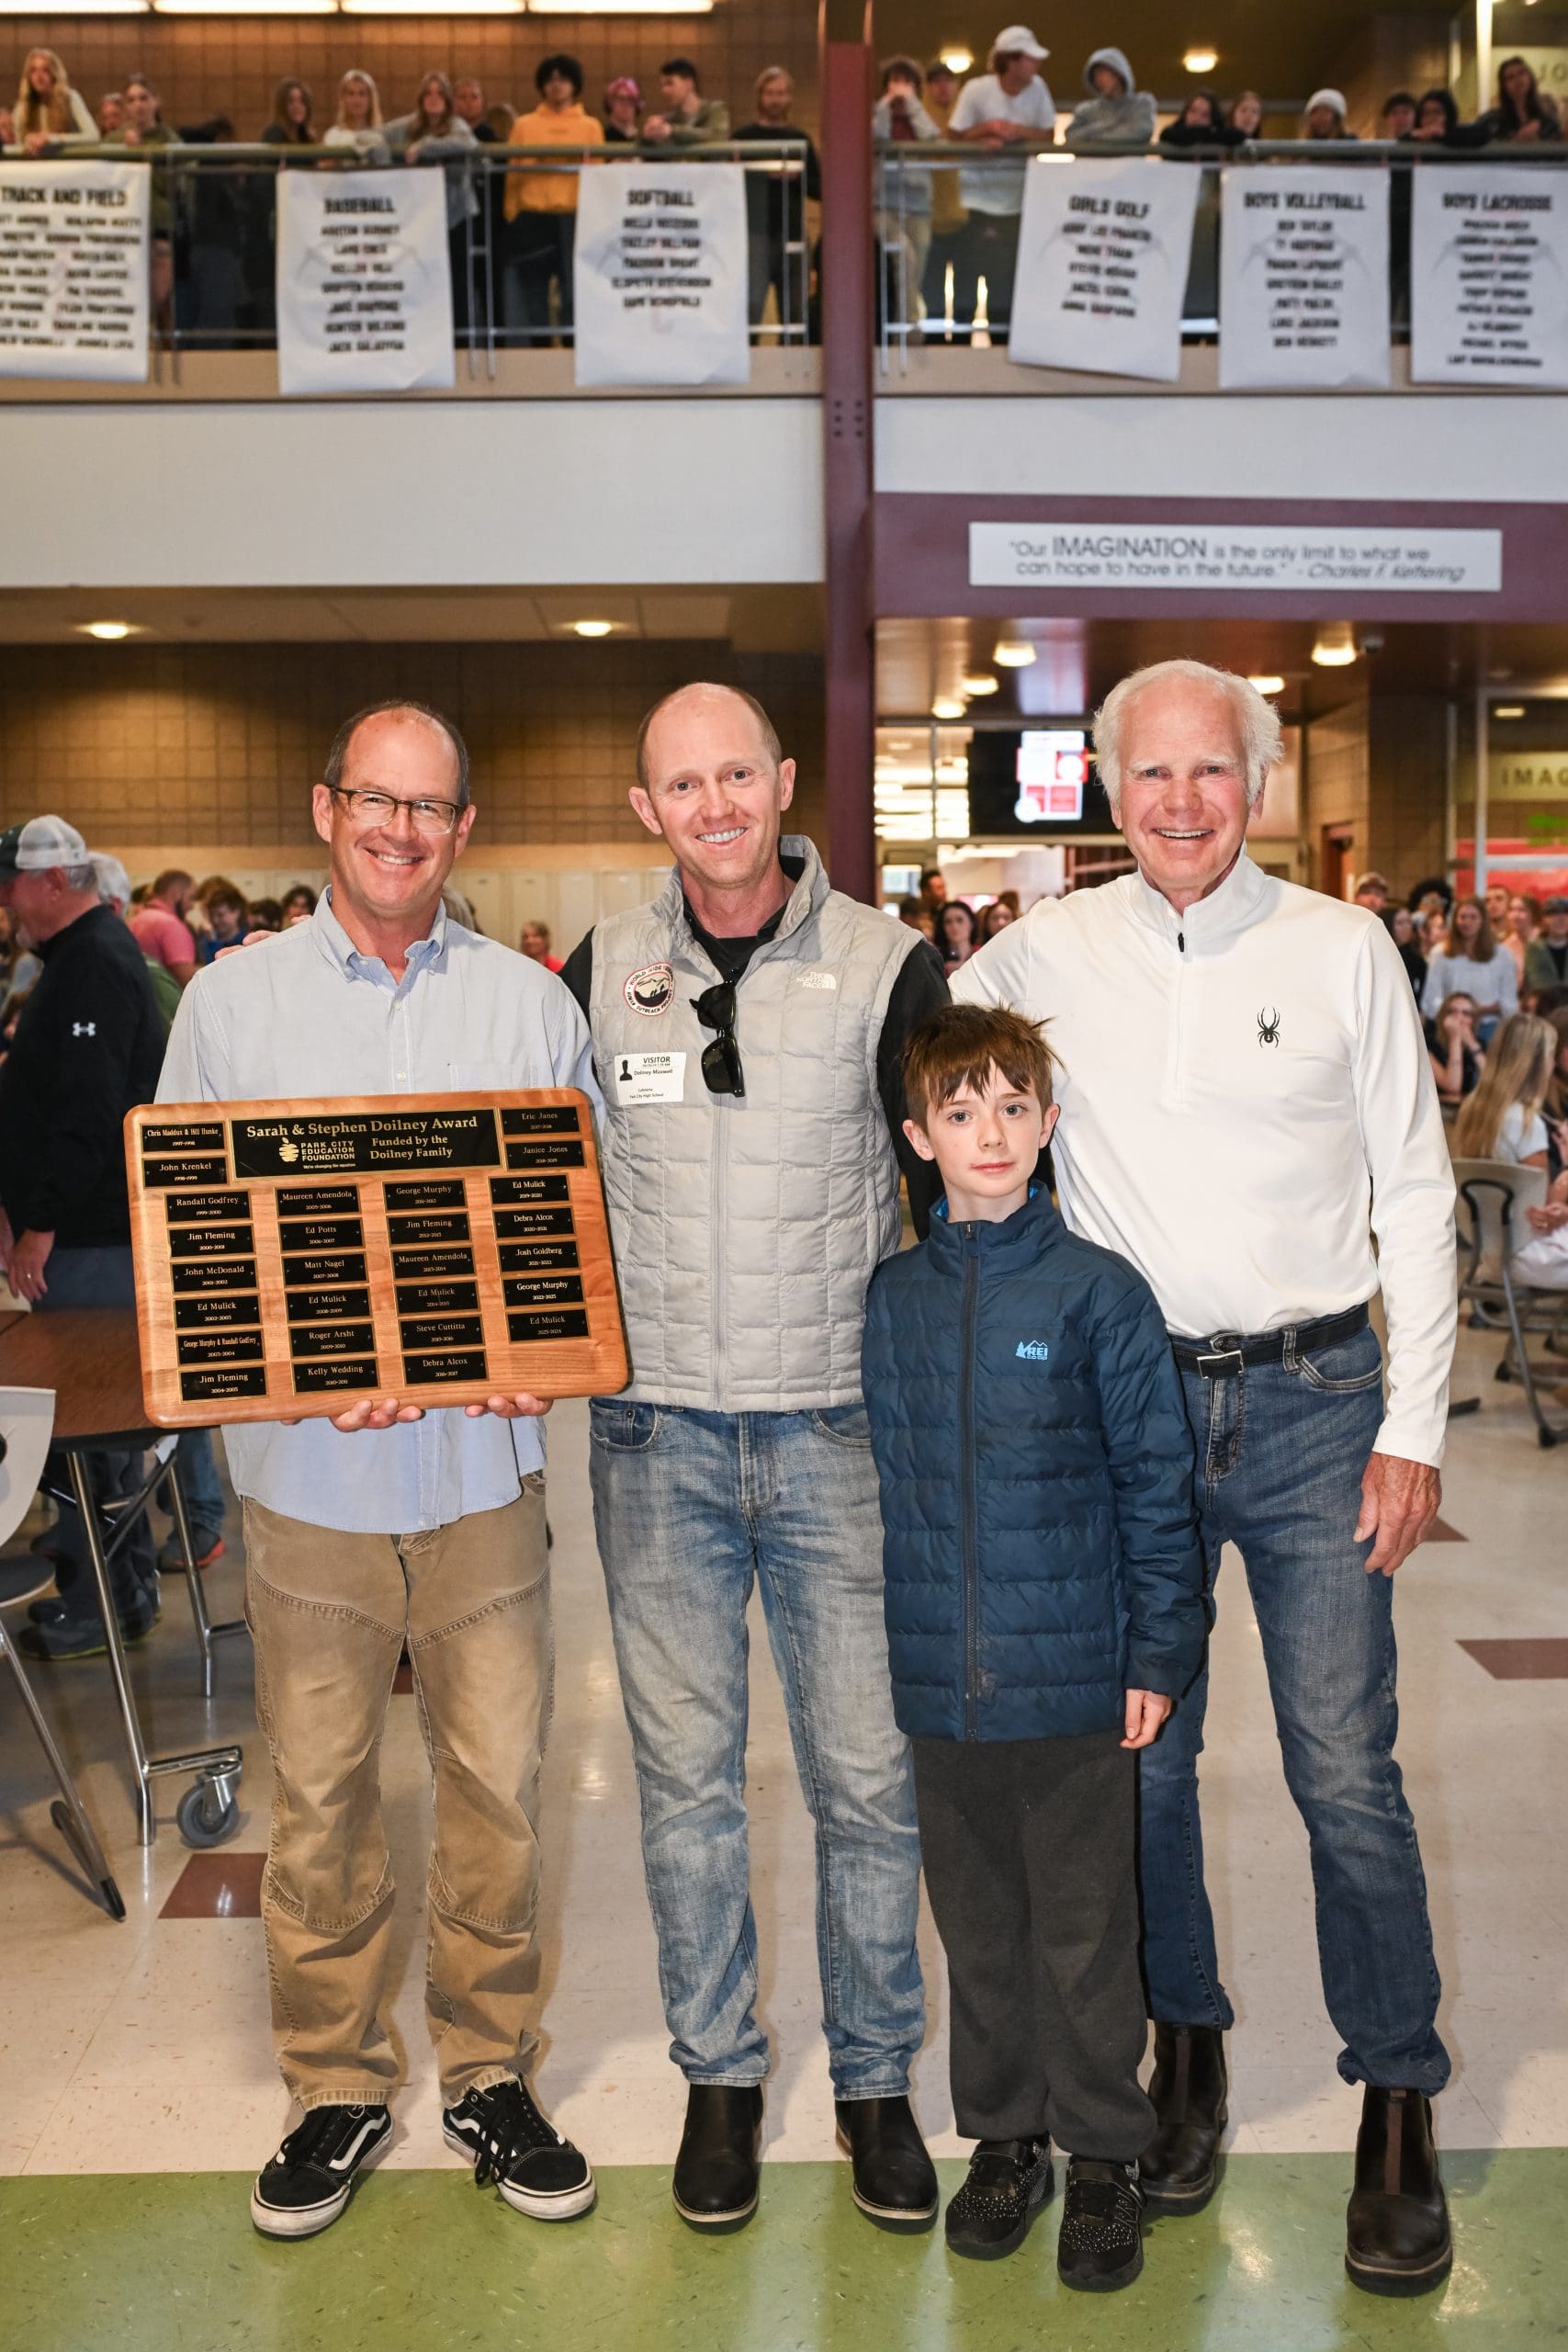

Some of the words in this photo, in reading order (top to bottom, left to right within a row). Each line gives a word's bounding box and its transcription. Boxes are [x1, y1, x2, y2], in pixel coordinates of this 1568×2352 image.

[1, 187, 46, 203] TRACK
[52, 189, 81, 205] AND
[86, 189, 127, 208] FIELD
[627, 190, 694, 207] SOFTBALL
[1244, 193, 1279, 209] BOYS
[1285, 193, 1365, 210] VOLLEYBALL
[1443, 194, 1477, 209] BOYS
[1483, 195, 1551, 210] LACROSSE
[324, 197, 396, 214] BASEBALL
[1068, 196, 1111, 214] GIRLS
[1115, 200, 1150, 219] GOLF
[1052, 537, 1207, 558] IMAGINATION
[1214, 544, 1226, 559] is
[1231, 544, 1258, 559] the
[1262, 545, 1295, 561] only
[1301, 545, 1336, 560] limit
[1340, 546, 1357, 560] to
[1359, 546, 1401, 560] what
[1406, 548, 1431, 561] we
[1016, 562, 1049, 576] can
[1055, 560, 1101, 578] hope
[1106, 561, 1122, 575] to
[1126, 561, 1170, 576] have
[1176, 561, 1190, 576] in
[1195, 561, 1221, 576] the
[1306, 562, 1371, 579] Charles
[1391, 564, 1466, 582] Kettering
[630, 969, 647, 986] WORLD
[636, 1005, 660, 1014] OUTREACH
[522, 1113, 536, 1121] Eric
[246, 1124, 288, 1137] Sarah
[292, 1124, 305, 1136] &
[308, 1122, 367, 1137] Stephen
[370, 1119, 428, 1133] Doilney
[432, 1116, 478, 1129] Award
[371, 1136, 412, 1147] Funded
[415, 1136, 428, 1147] by
[431, 1135, 448, 1144] the
[301, 1147, 355, 1155] EDUCATION
[369, 1149, 413, 1160] Doilney
[416, 1147, 453, 1159] Family
[302, 1153, 355, 1161] FOUNDATION
[158, 1163, 179, 1171] John
[182, 1162, 212, 1170] Krenkel
[396, 1187, 422, 1195] George
[423, 1185, 452, 1193] Murphy
[524, 1181, 546, 1189] Mulick
[176, 1198, 206, 1206] Randall
[208, 1196, 239, 1204] Godfrey
[282, 1193, 313, 1201] Maureen
[316, 1191, 353, 1199] Amendola
[423, 1219, 453, 1227] Fleming
[318, 1226, 337, 1234] Potts
[205, 1231, 236, 1240] Fleming
[399, 1255, 429, 1263] Maureen
[432, 1252, 468, 1261] Amendola
[515, 1249, 532, 1257] Josh
[324, 1260, 345, 1269] Nagel
[184, 1268, 204, 1276] John
[206, 1266, 244, 1274] McDonald
[516, 1283, 541, 1291] George
[542, 1281, 569, 1290] Murphy
[418, 1289, 428, 1297] Ed
[430, 1288, 456, 1296] Mulick
[309, 1296, 319, 1305] Ed
[321, 1295, 347, 1304] Mulick
[197, 1303, 208, 1311] Ed
[210, 1302, 237, 1310] Mulick
[542, 1316, 566, 1324] Mulick
[437, 1323, 466, 1331] Cuttitta
[309, 1332, 331, 1340] Roger
[333, 1330, 355, 1339] Arsht
[1027, 1347, 1048, 1356] REI
[423, 1359, 445, 1367] Debra
[446, 1358, 468, 1366] Alcox
[308, 1367, 329, 1376] Kelly
[331, 1365, 364, 1374] Wedding
[198, 1375, 215, 1384] Jim
[217, 1374, 249, 1383] Fleming
